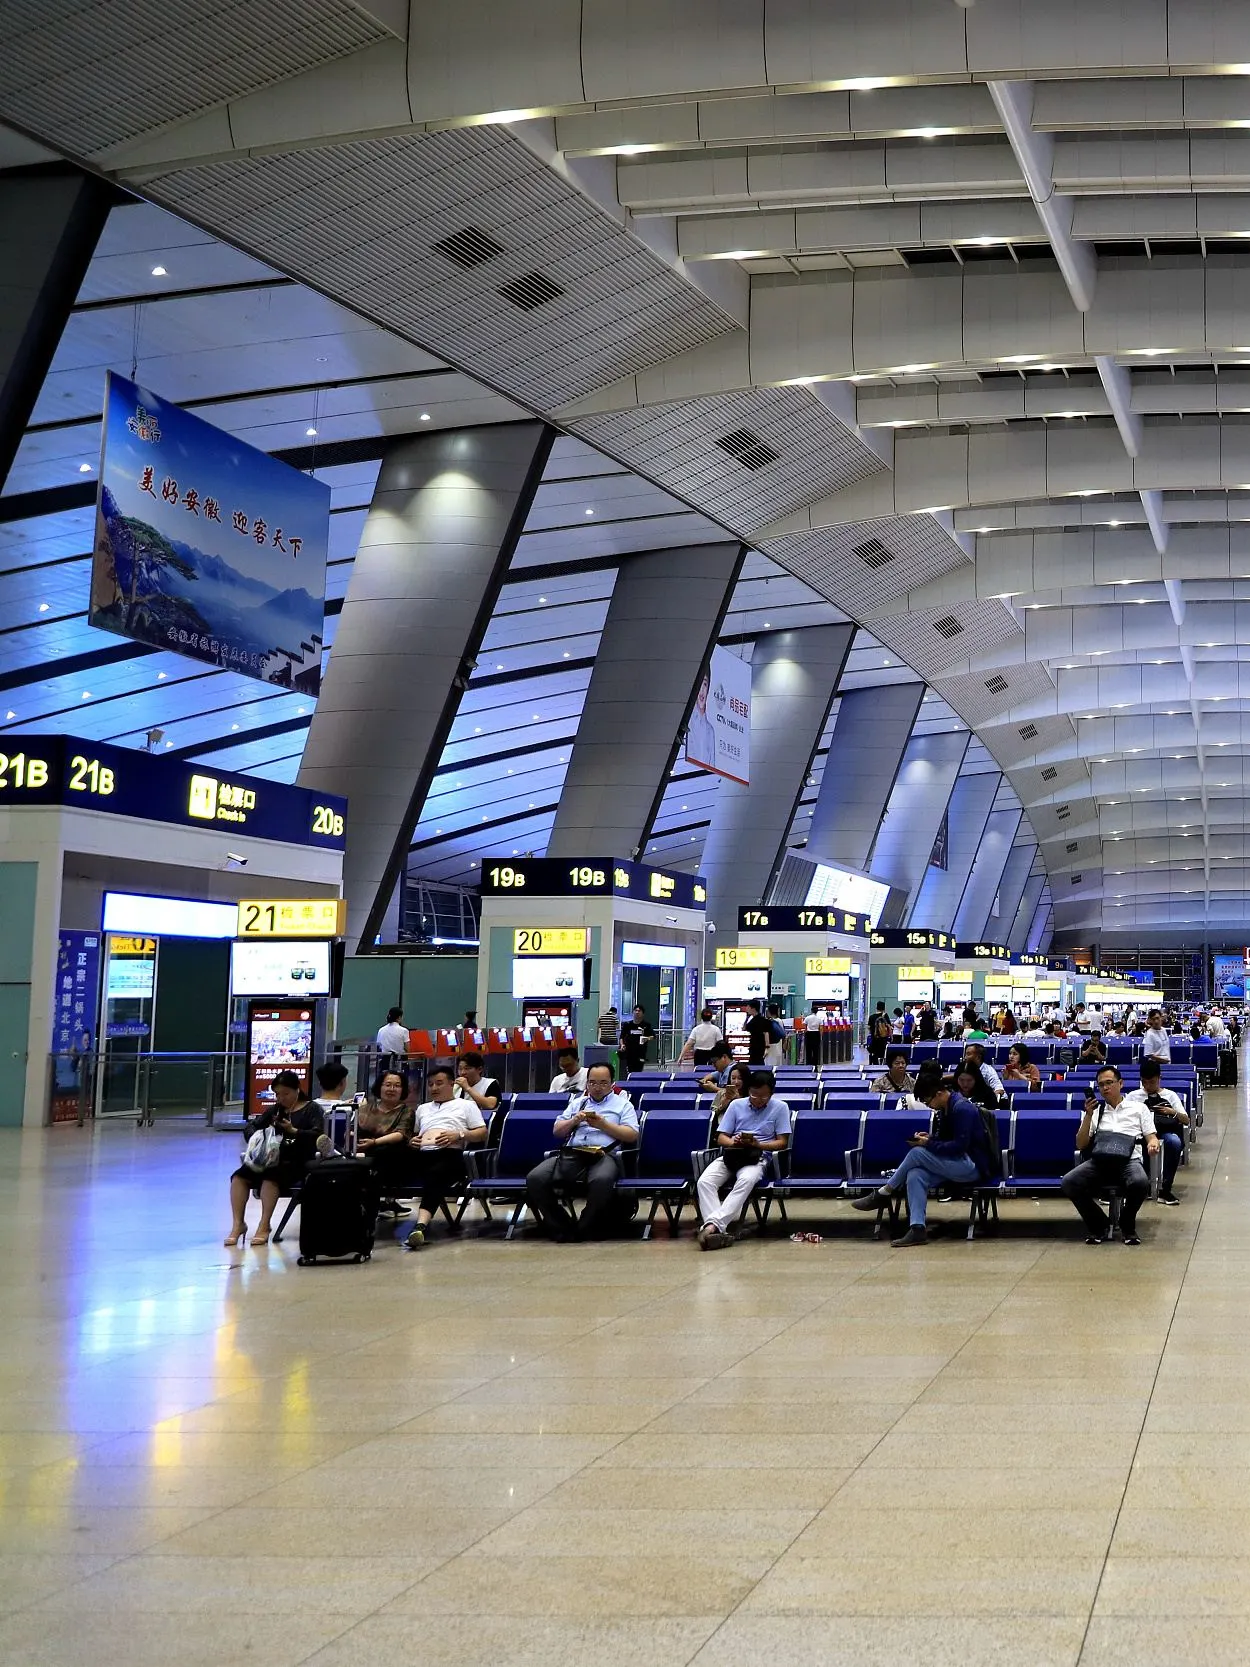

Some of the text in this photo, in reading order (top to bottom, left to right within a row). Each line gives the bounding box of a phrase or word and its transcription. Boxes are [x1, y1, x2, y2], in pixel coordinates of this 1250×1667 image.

[137, 465, 303, 559] 美好安徽 迎客天下
[69, 756, 114, 795] 21B
[218, 783, 257, 810] 检票口
[217, 807, 239, 822] Check
[312, 806, 344, 836] 20B
[490, 867, 525, 887] 19B
[569, 867, 605, 887] 19B
[245, 905, 275, 931] 21
[744, 911, 769, 926] 17B
[798, 911, 823, 926] 17B
[517, 930, 542, 951] 20
[870, 933, 885, 945] 5B
[906, 933, 926, 945] 15B
[720, 950, 737, 965] 19
[808, 959, 823, 971] 18
[901, 968, 912, 977] 17
[74, 953, 87, 1032] 正宗二锅头
